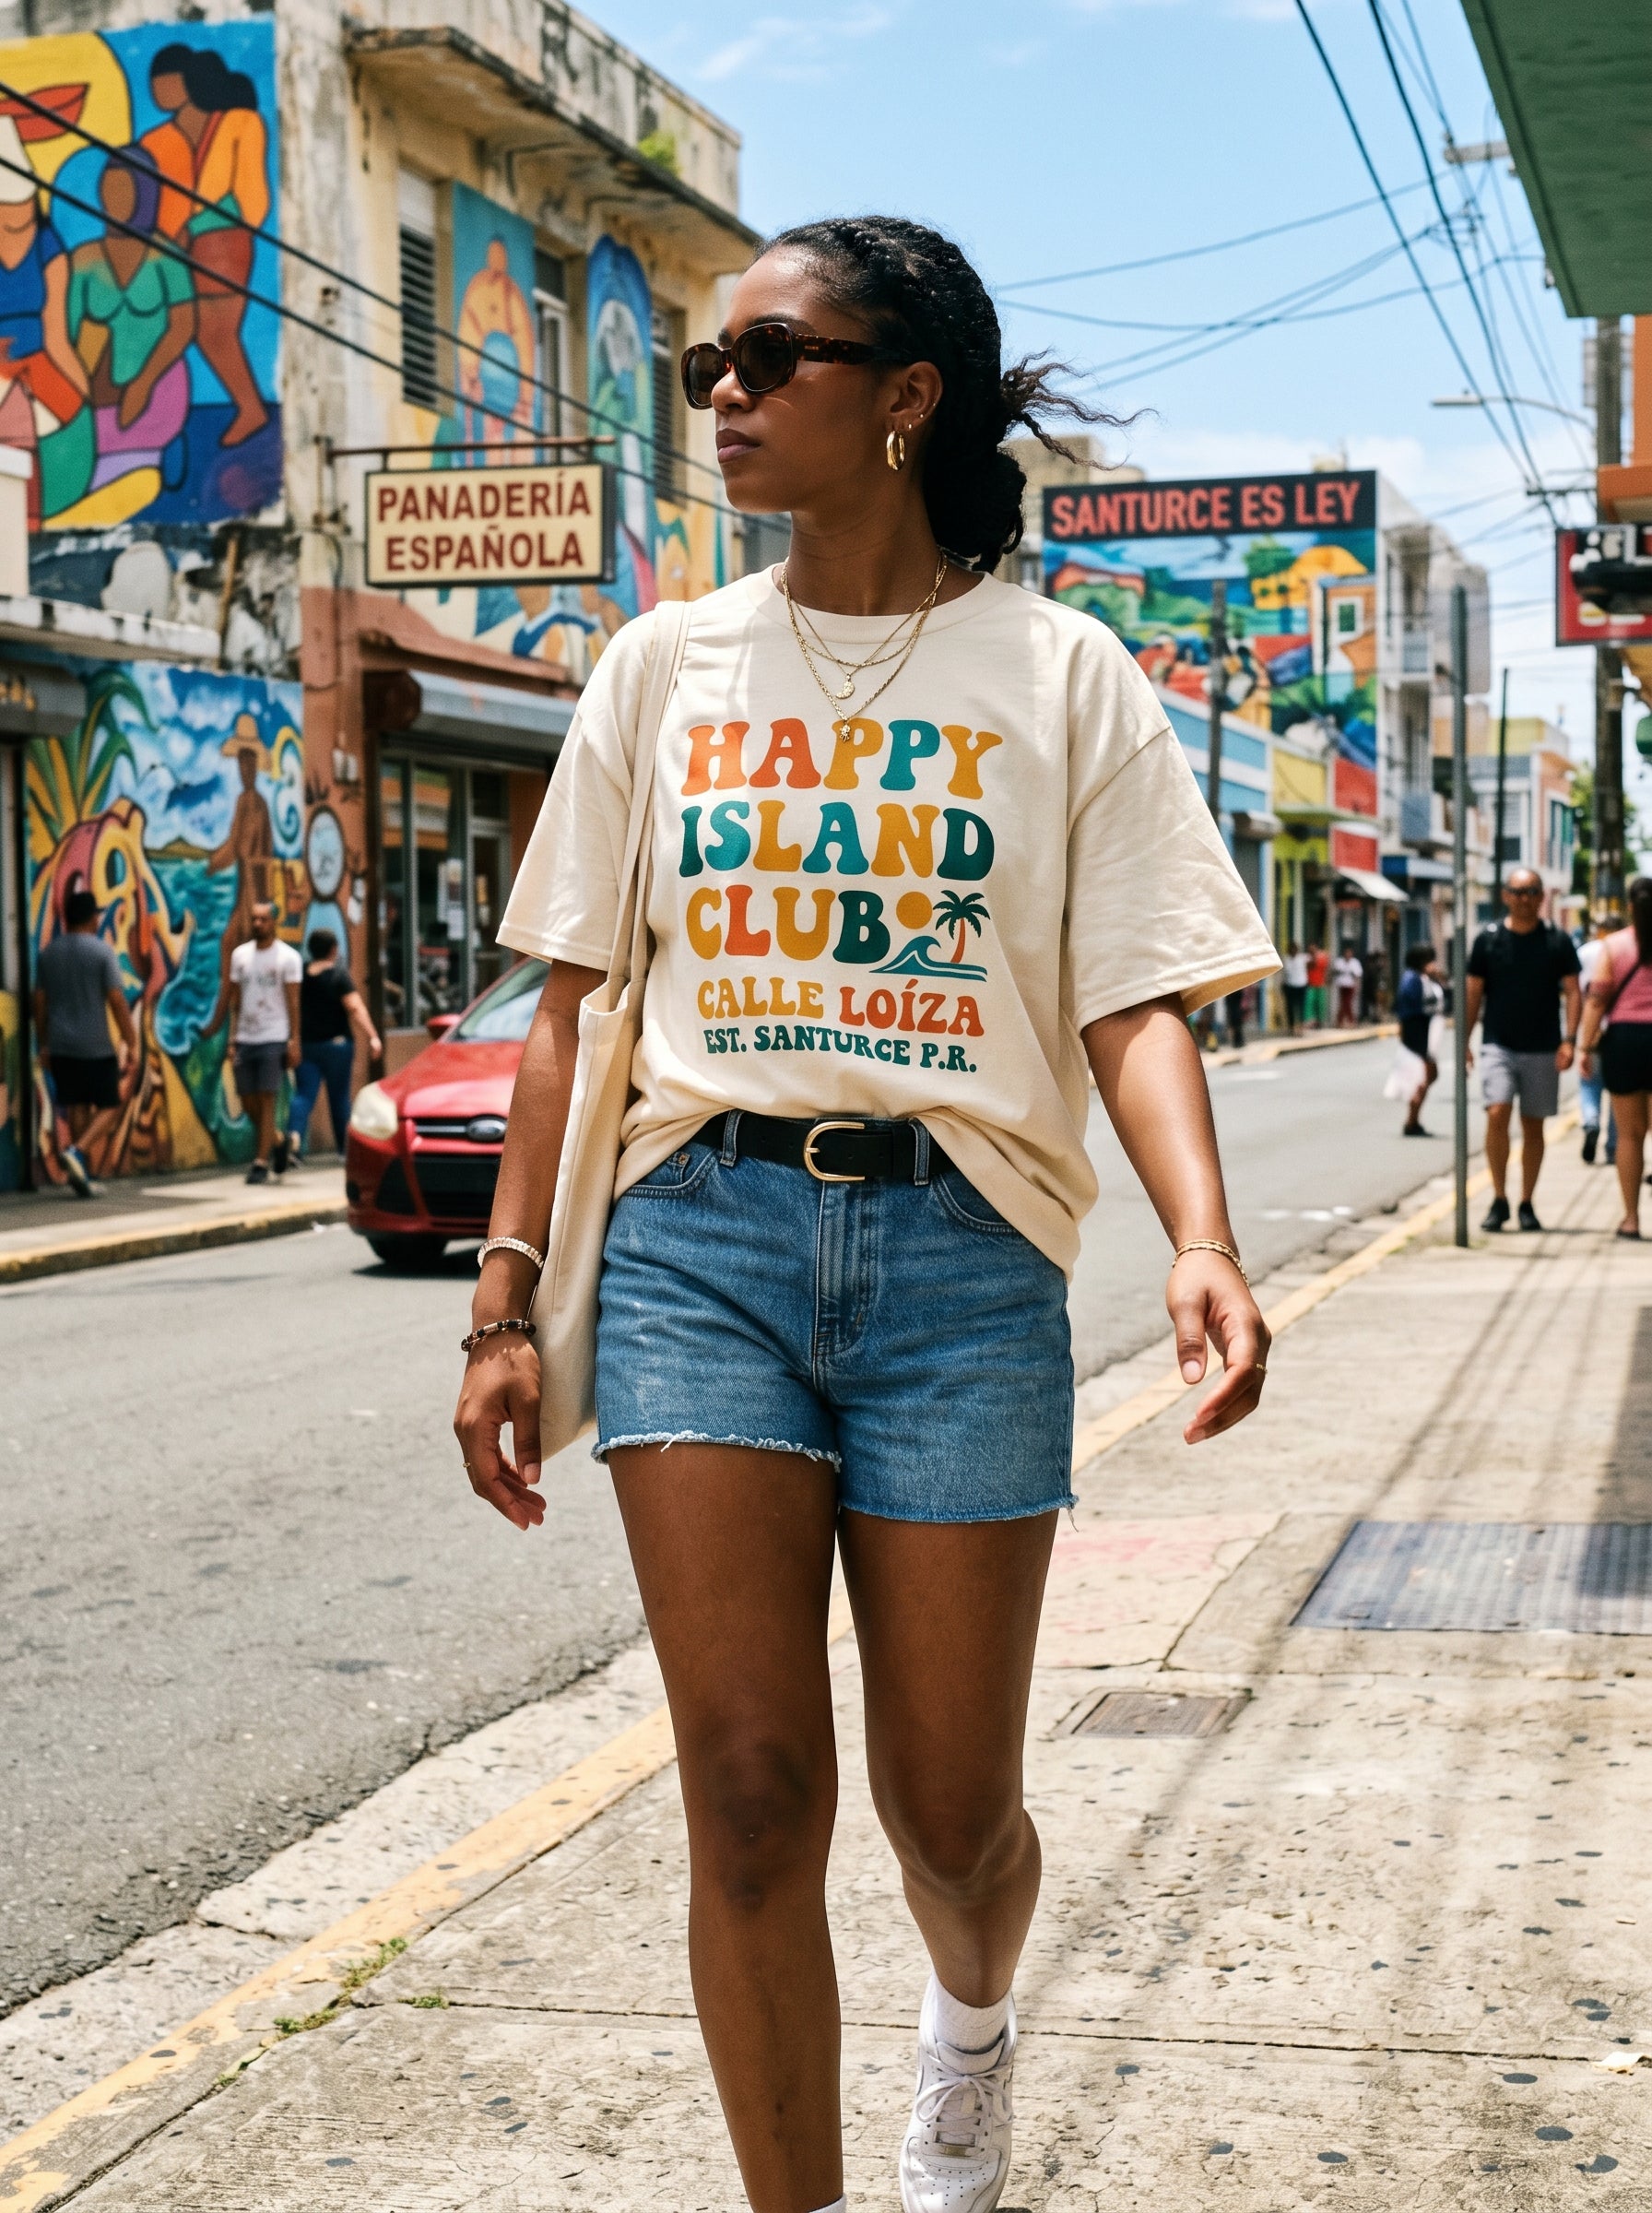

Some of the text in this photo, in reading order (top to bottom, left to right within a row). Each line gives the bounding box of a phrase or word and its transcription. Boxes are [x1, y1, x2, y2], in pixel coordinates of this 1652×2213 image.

[378, 471, 591, 522] PANADERÍA
[1051, 480, 1361, 538] SANTURCE ES LEY
[385, 525, 584, 572] ESPAÑOLA
[680, 717, 1003, 799] HAPPY
[678, 799, 995, 881] ISLAND
[686, 884, 891, 964] CLUB
[697, 976, 985, 1037] CALLE LOÍZA
[703, 1024, 977, 1073] EST. SANTURCE P.R.
